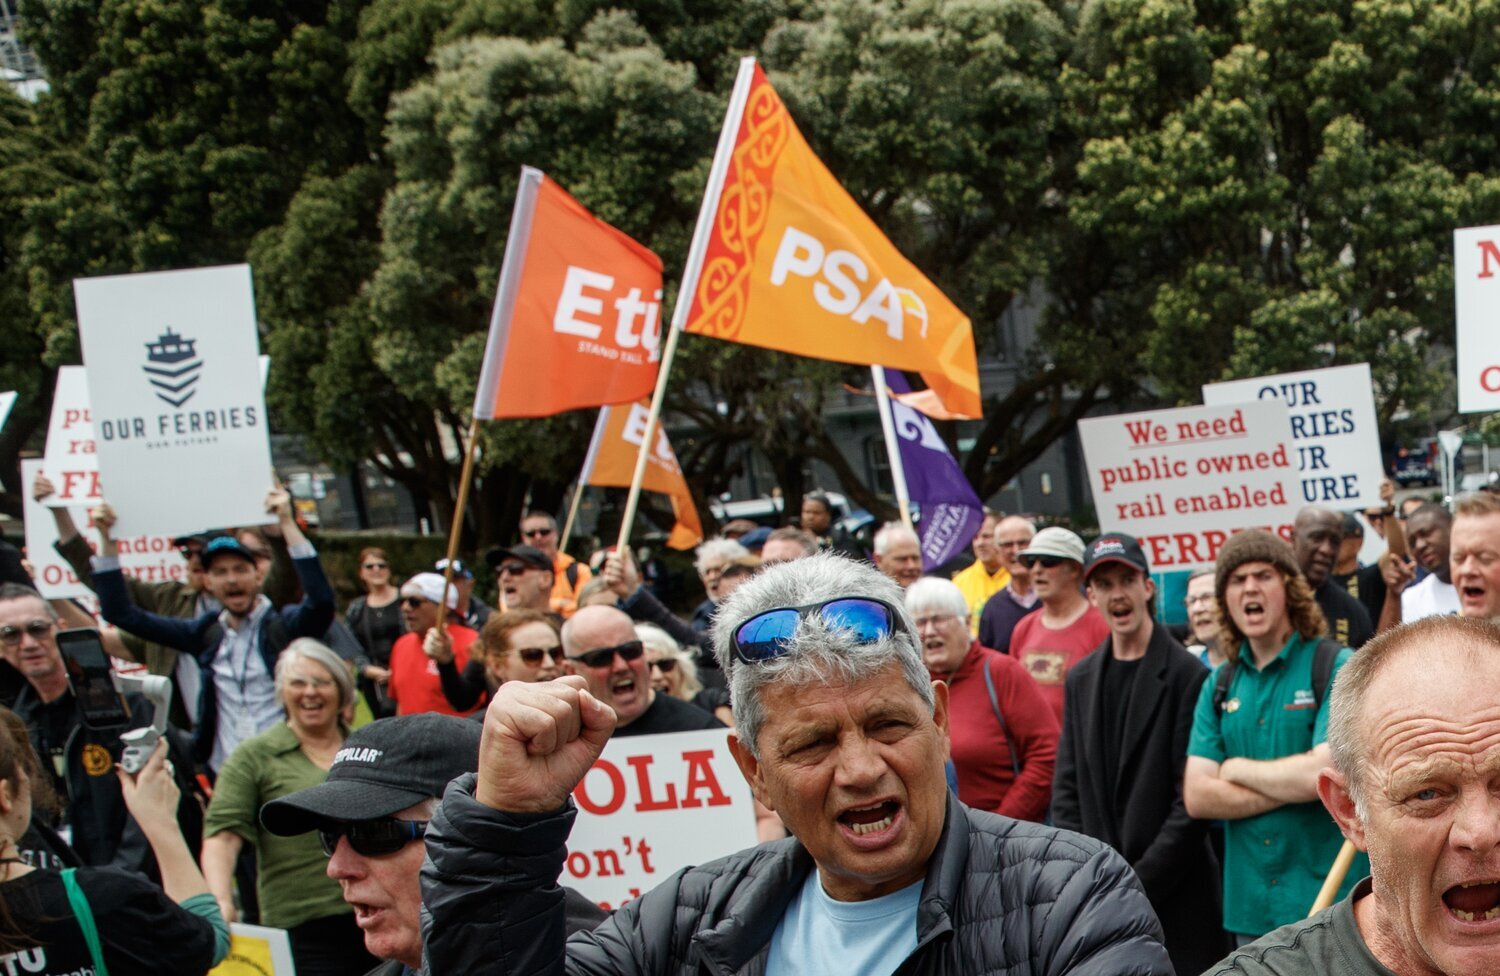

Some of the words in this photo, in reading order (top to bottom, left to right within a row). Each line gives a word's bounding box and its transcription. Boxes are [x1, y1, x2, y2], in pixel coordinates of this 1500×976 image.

[770, 225, 904, 341] PSA
[102, 416, 146, 441] OUR
[159, 406, 258, 436] FERRIES
[1124, 420, 1169, 445] We
[1177, 409, 1247, 440] need
[1099, 454, 1188, 492] public
[1196, 443, 1290, 475] owned
[1116, 493, 1166, 520] rail
[1174, 483, 1288, 514] enabled
